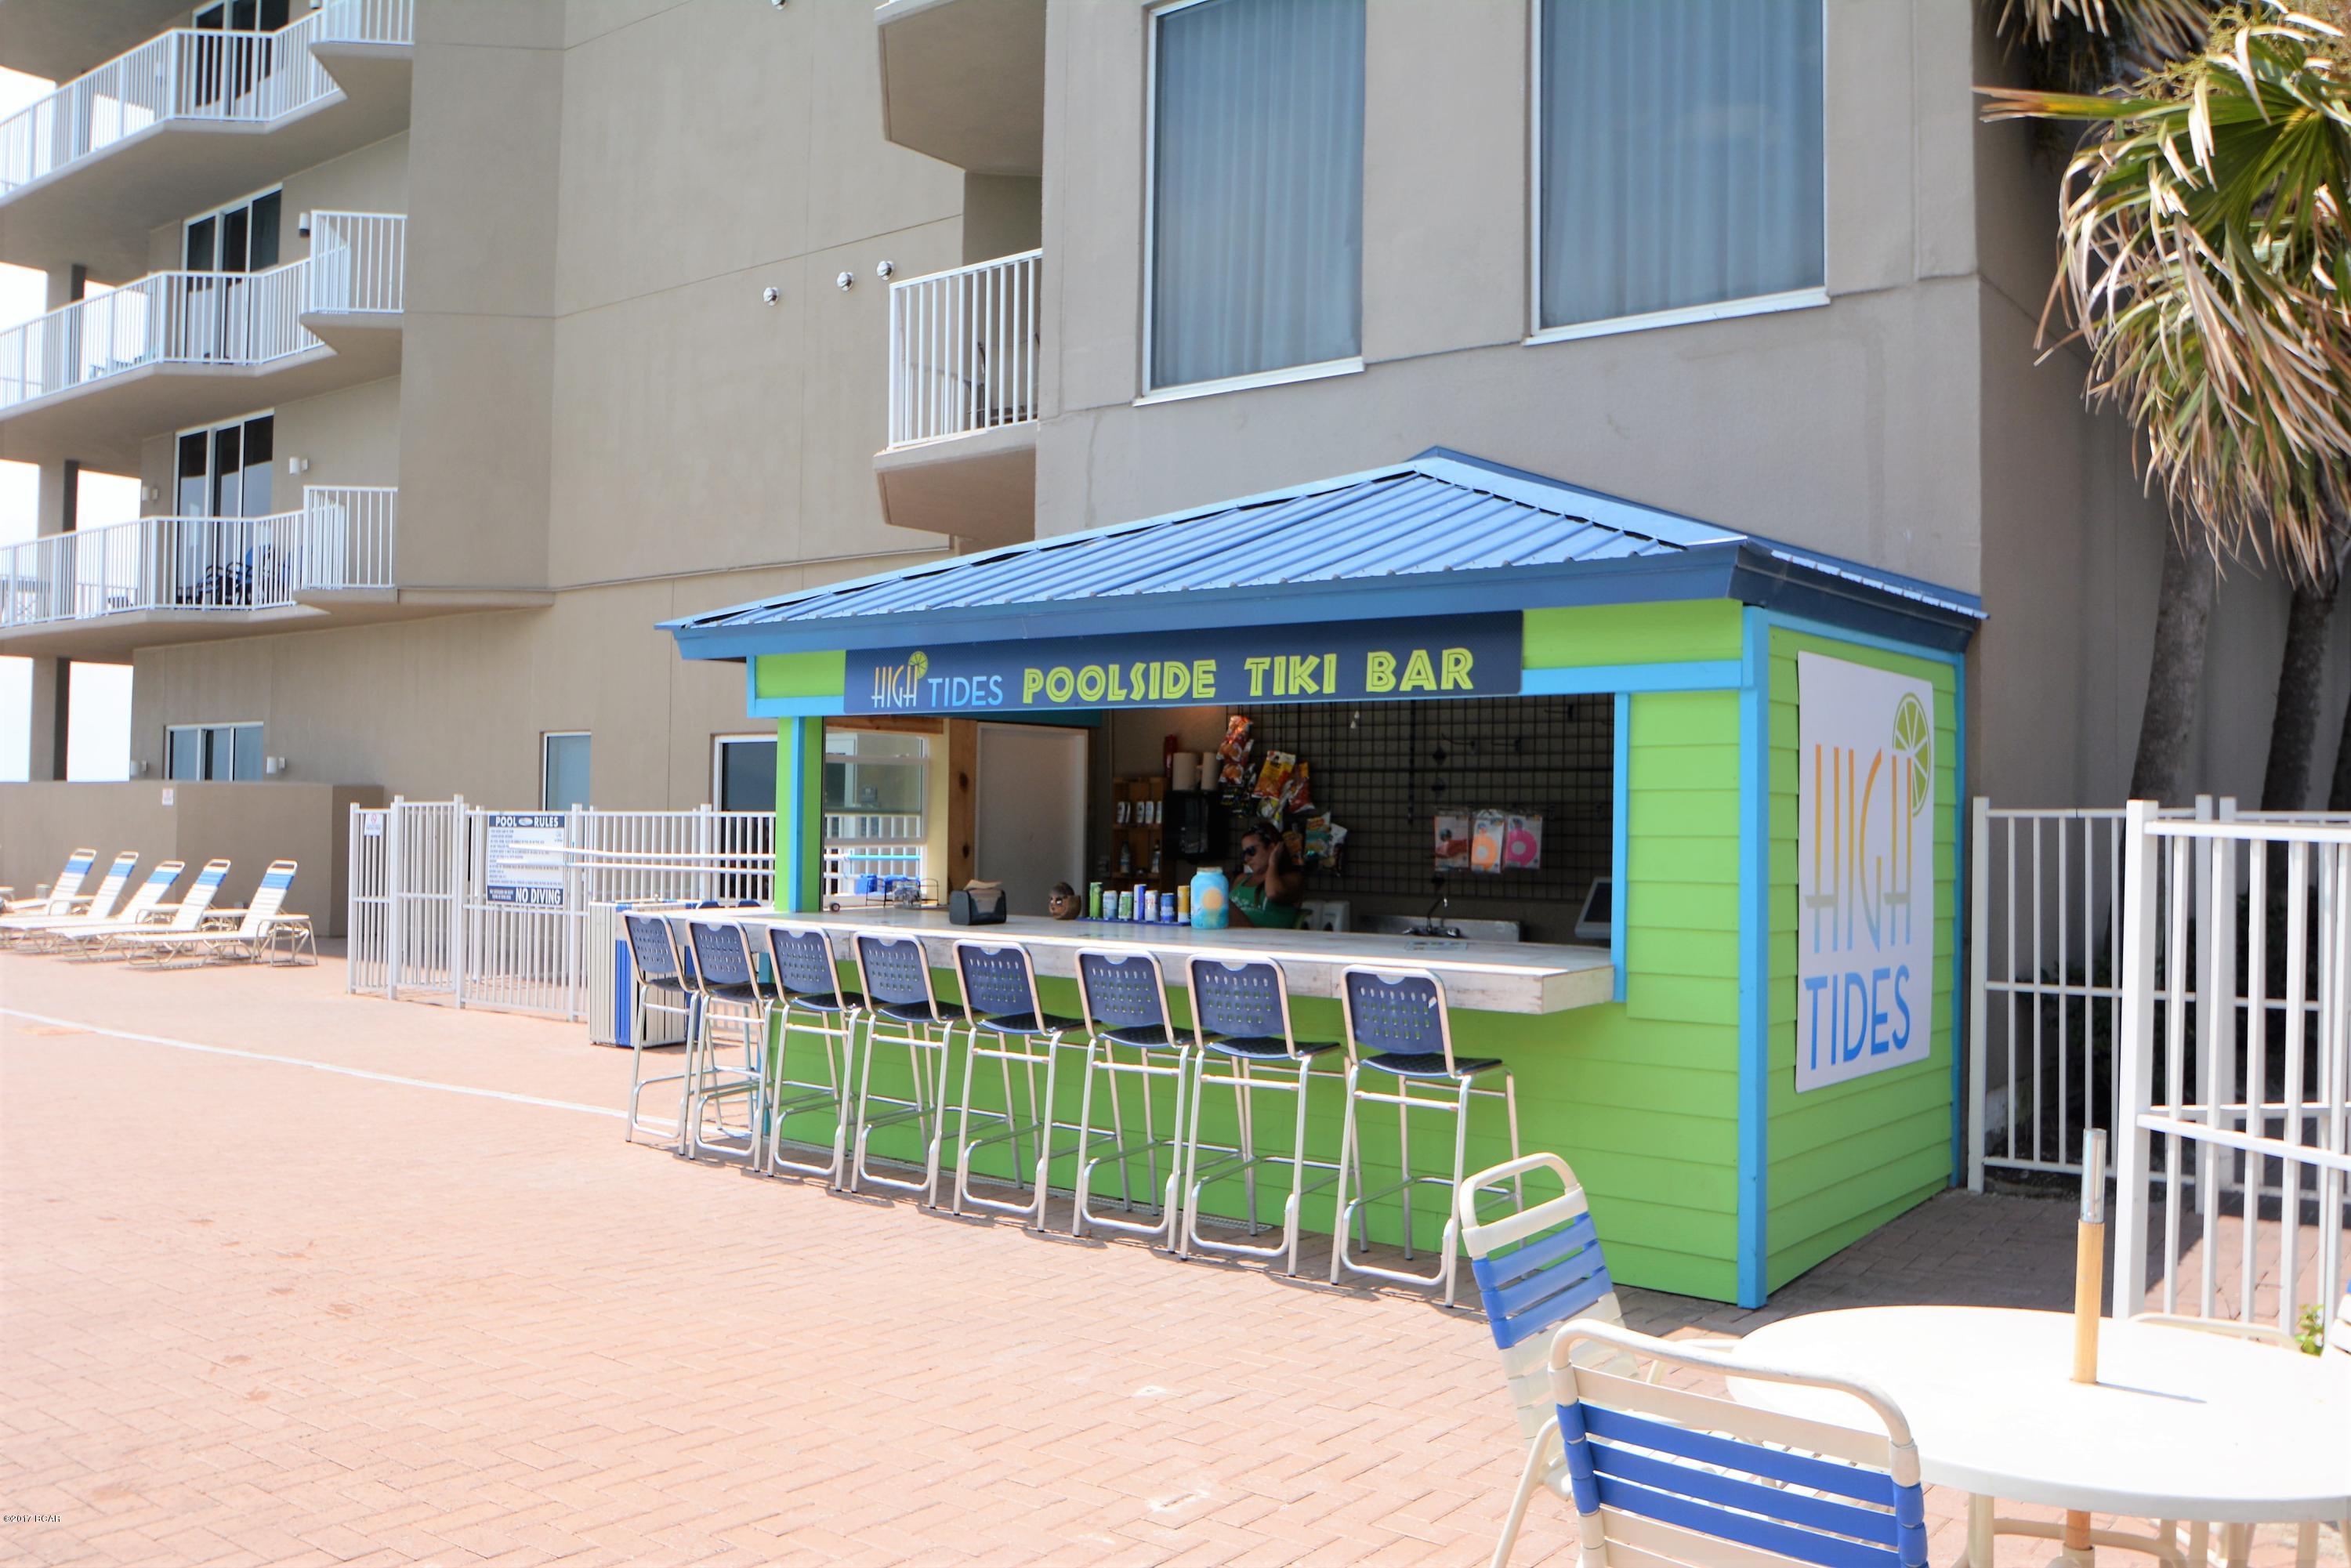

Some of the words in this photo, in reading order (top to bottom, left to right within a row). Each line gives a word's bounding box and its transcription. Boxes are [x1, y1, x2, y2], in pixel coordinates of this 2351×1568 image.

[871, 664, 918, 708] HIGH
[928, 675, 1003, 708] TIDES
[1023, 659, 1216, 704] POOLSIDE
[1244, 654, 1336, 696] TIKI
[1366, 647, 1473, 692] BAR
[495, 816, 517, 827] POOL
[534, 816, 559, 827] RULES
[1804, 744, 1912, 953] HIGH
[516, 886, 529, 903] NO
[531, 888, 561, 904] DIVING
[1804, 964, 1910, 1071] TIDES
